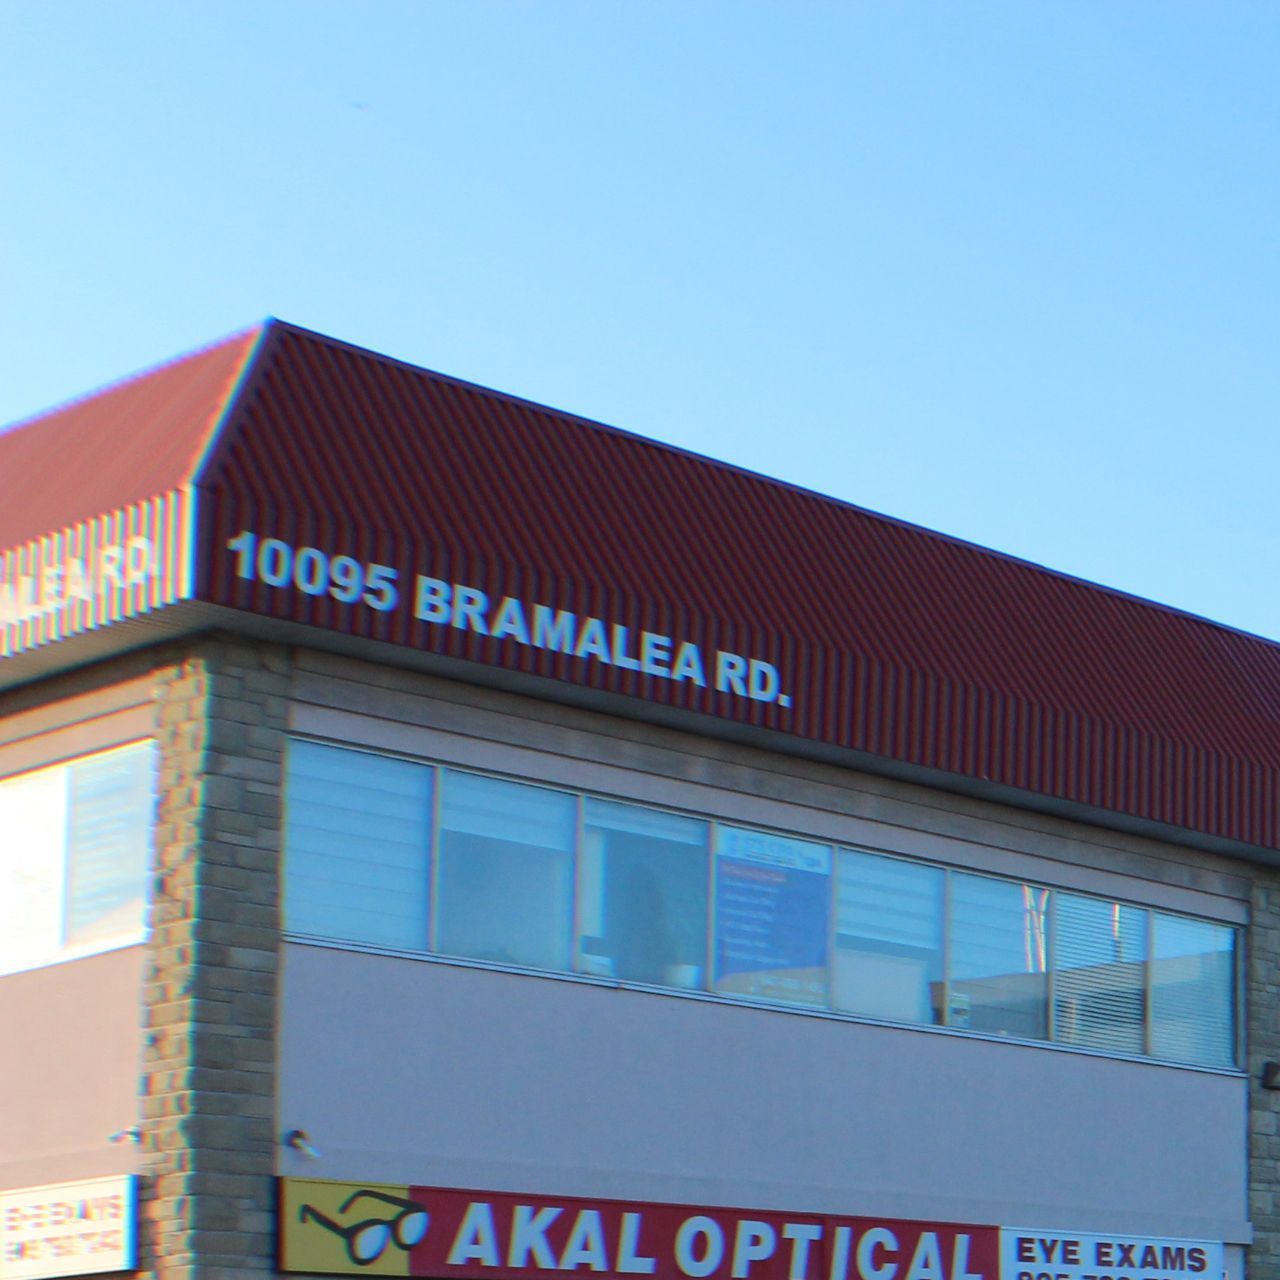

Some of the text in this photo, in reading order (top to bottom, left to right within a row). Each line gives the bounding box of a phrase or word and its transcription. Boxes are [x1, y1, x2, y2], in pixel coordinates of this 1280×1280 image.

[227, 530, 792, 707] 10095 BRAMALEA RD.
[447, 1202, 656, 1274] AKAL
[1016, 1237, 1207, 1272] EYE EXAMS
